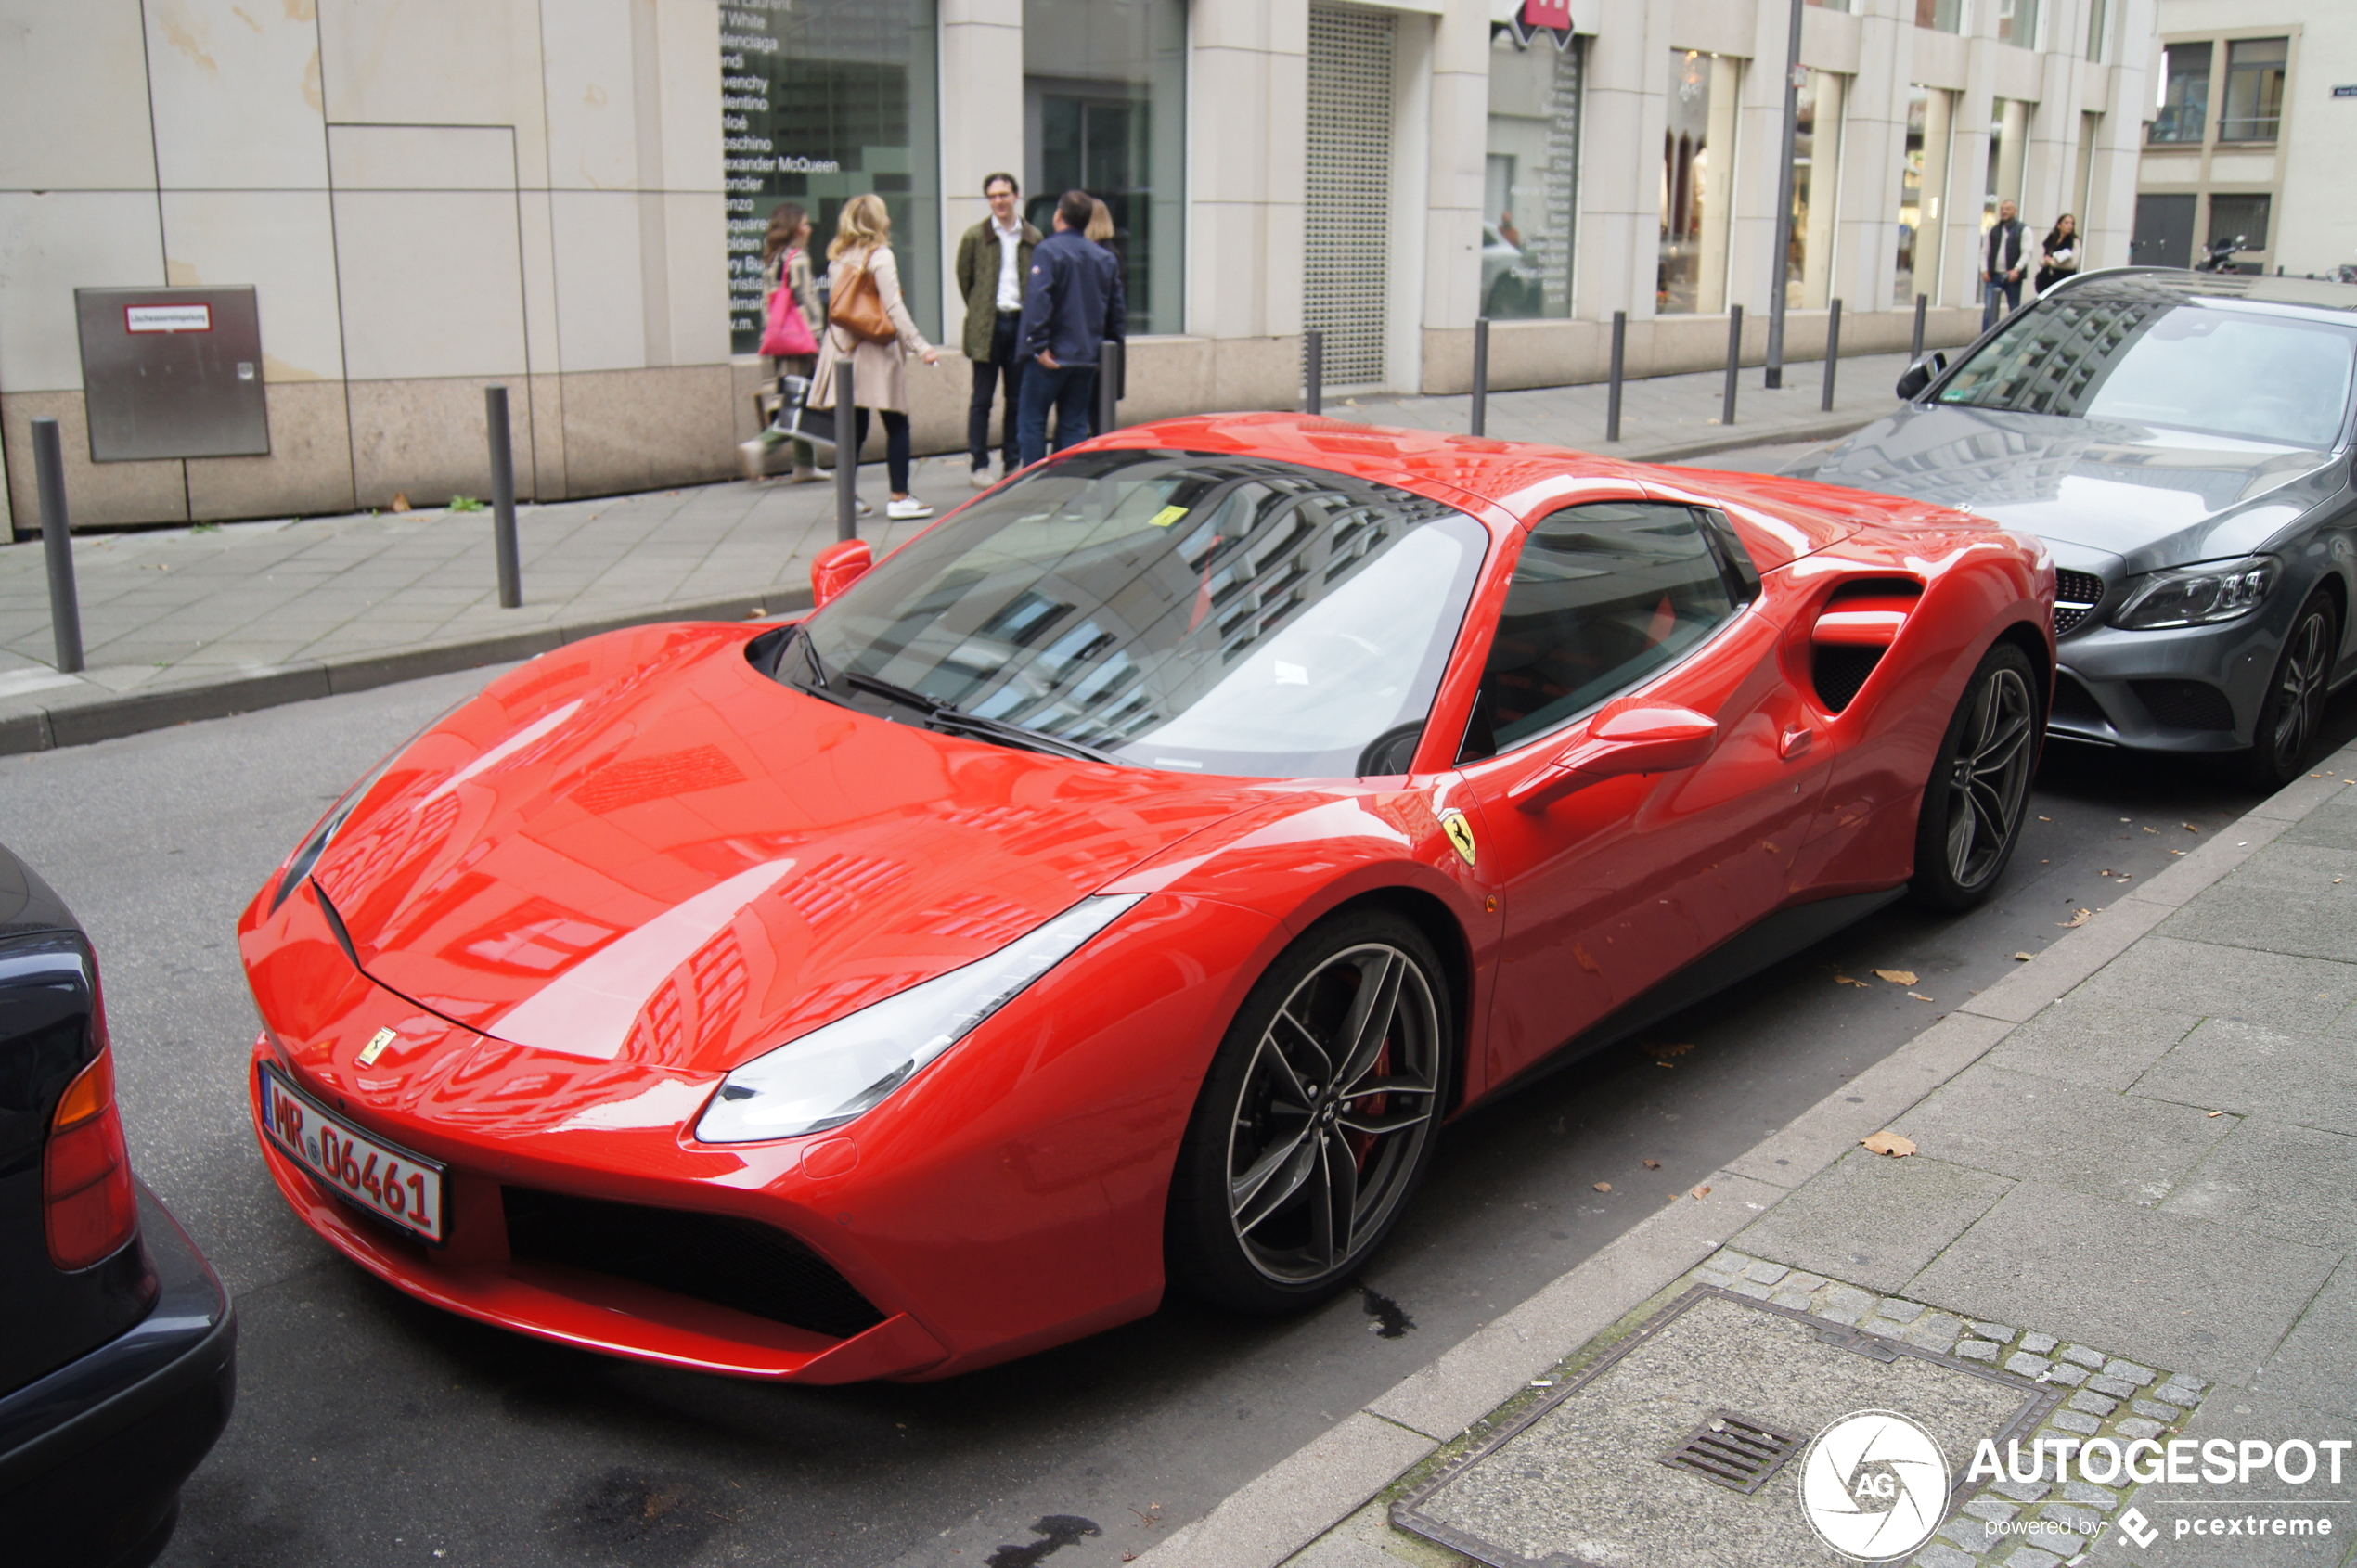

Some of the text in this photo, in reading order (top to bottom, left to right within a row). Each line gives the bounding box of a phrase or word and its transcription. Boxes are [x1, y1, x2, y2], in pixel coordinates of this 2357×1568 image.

[728, 10, 766, 30] White
[778, 156, 840, 174] McQueen
[273, 1086, 307, 1156] MR
[320, 1125, 431, 1228] 06461
